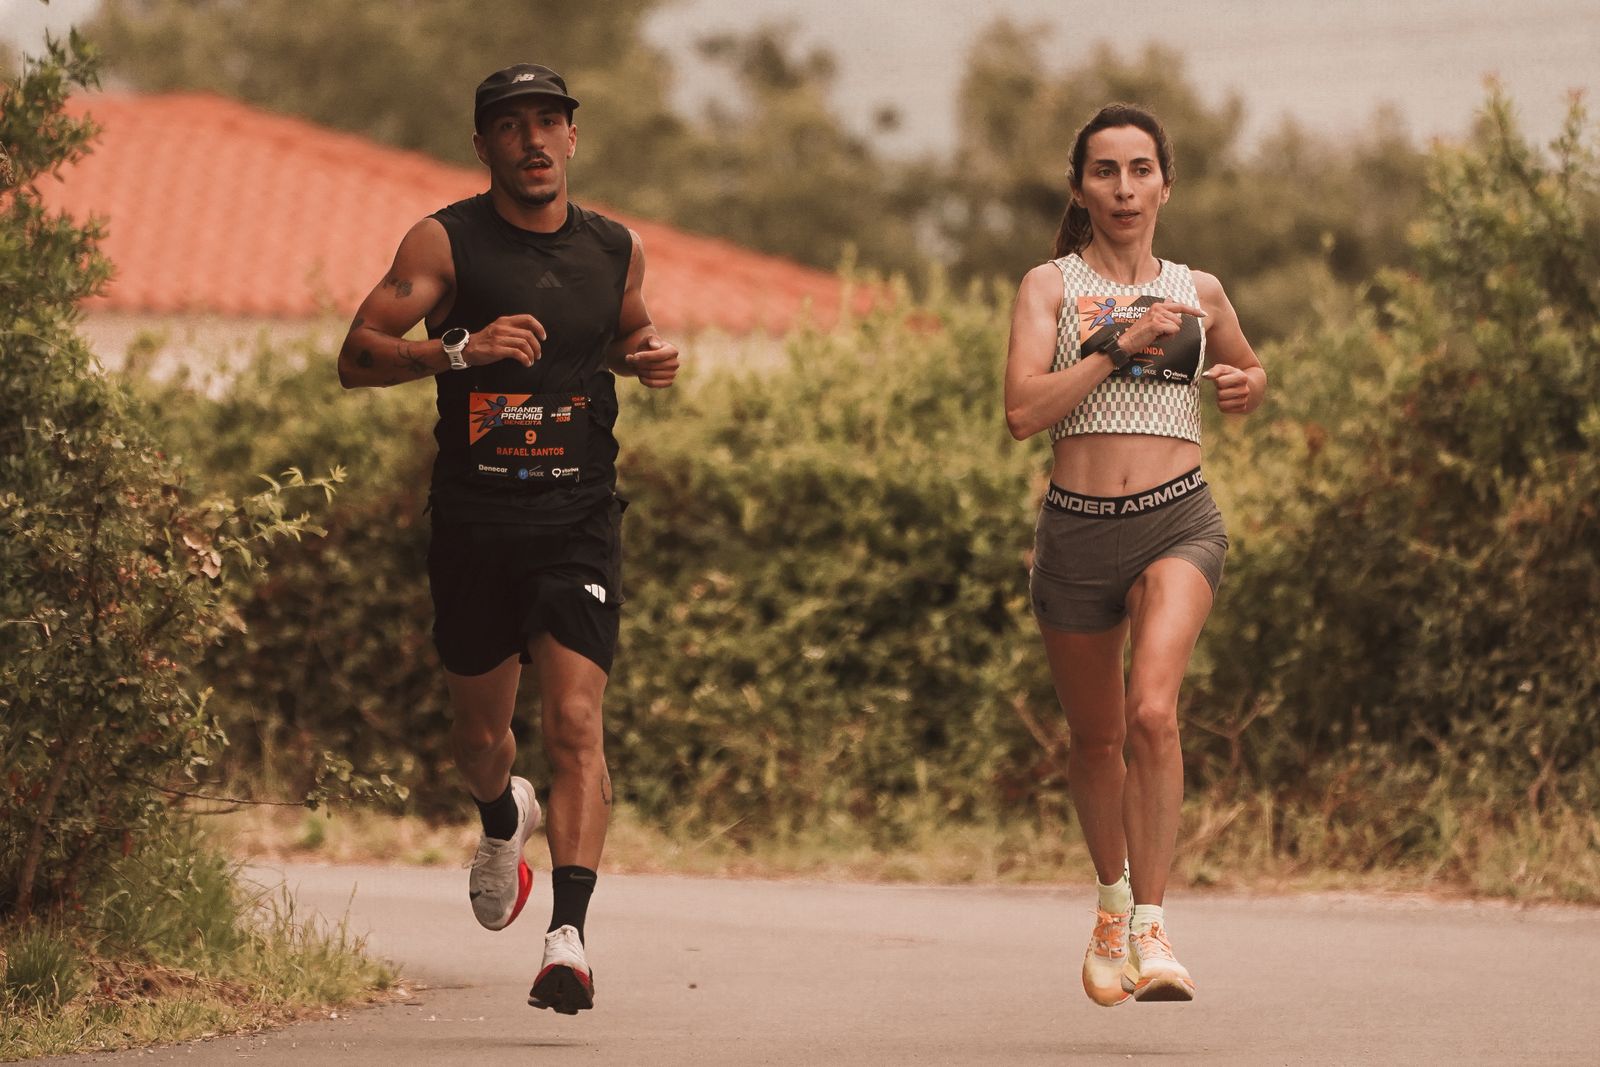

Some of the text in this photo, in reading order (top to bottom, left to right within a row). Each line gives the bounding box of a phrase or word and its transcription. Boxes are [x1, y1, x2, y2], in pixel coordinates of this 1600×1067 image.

[500, 412, 543, 420] PRÉMIO
[524, 429, 537, 445] 9
[496, 447, 565, 456] RAFAEL SANTOS
[1046, 470, 1205, 515] UNDER ARMOUR
